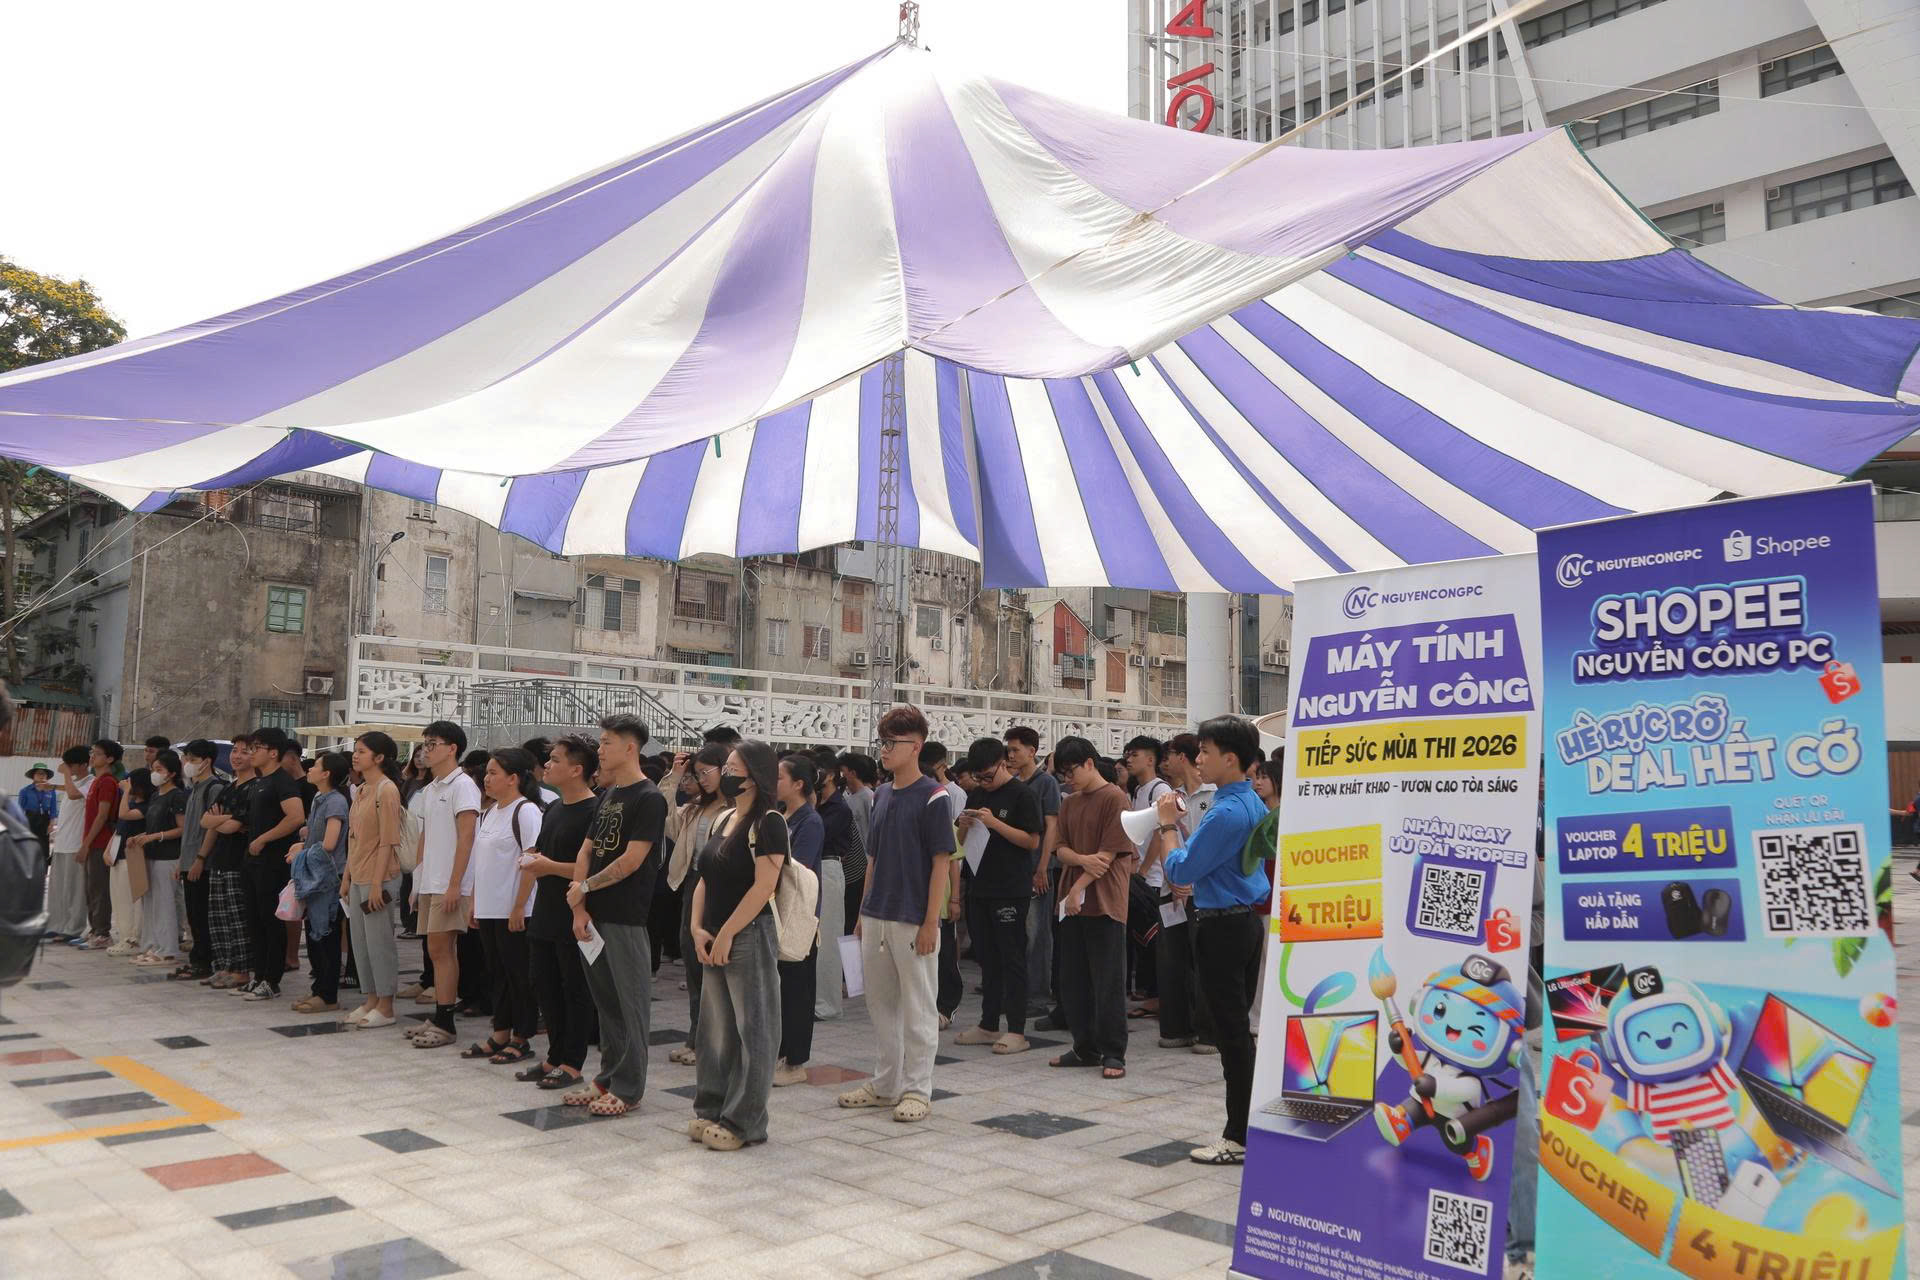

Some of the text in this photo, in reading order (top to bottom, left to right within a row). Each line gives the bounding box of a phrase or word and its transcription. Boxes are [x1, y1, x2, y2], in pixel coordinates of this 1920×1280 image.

[1596, 548, 1703, 572] NGUYENCONGPC
[1756, 535, 1831, 556] Shopee
[1381, 585, 1484, 604] NGUYENCONGPC
[1597, 581, 1802, 641] SHOPEE
[1327, 624, 1504, 675] MÁY TÍNH
[1577, 638, 1832, 677] NGUYỄN CÔNG PC
[1299, 669, 1529, 720] NGUYỄN CÔNG
[1558, 697, 1727, 762] HÈ RỰC RỠ
[1305, 732, 1518, 767] TIẾP SỨC MÙA THI 2026
[1587, 720, 1862, 793] DEAL HẾT CỠ
[1312, 783, 1337, 798] TRỌN
[1339, 779, 1363, 795] KHÁT
[1365, 781, 1390, 794] KHAO
[1435, 780, 1458, 793] CAO
[1487, 776, 1518, 793] SÁNG
[1403, 816, 1455, 840] NHẬN
[1458, 824, 1511, 844] NGAY
[1565, 830, 1616, 843] VOUCHER
[1622, 823, 1727, 862] 4 TRIỆU
[1290, 843, 1369, 867] VOUCHER
[1389, 835, 1527, 869] ƯU ĐÃI SHOPEE
[1568, 847, 1617, 861] LAPTOP
[1288, 894, 1371, 929] 4 TRIỆU
[1578, 891, 1642, 910] QUÀ TẶNG
[1585, 911, 1639, 929] HẤP DẪN
[1267, 1207, 1361, 1243] NGUYENCONGPC.VN
[1690, 1228, 1717, 1261] 4
